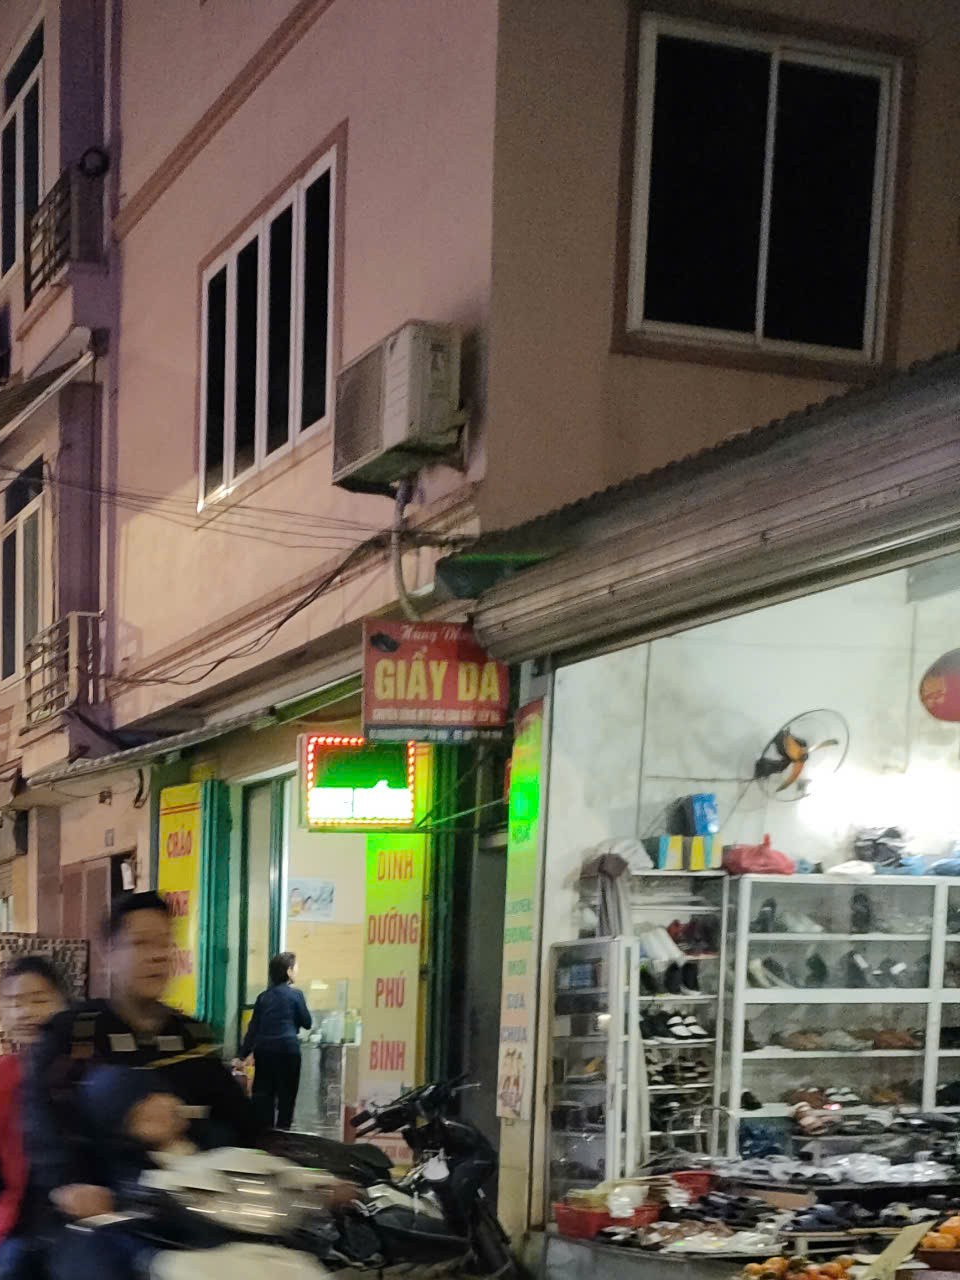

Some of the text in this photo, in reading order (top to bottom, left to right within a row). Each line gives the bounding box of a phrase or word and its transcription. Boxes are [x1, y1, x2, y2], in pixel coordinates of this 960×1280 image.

[457, 661, 500, 702] DA
[377, 850, 414, 881] DINH
[375, 969, 406, 1008] PHÚ
[369, 1033, 406, 1071] BÌNH
